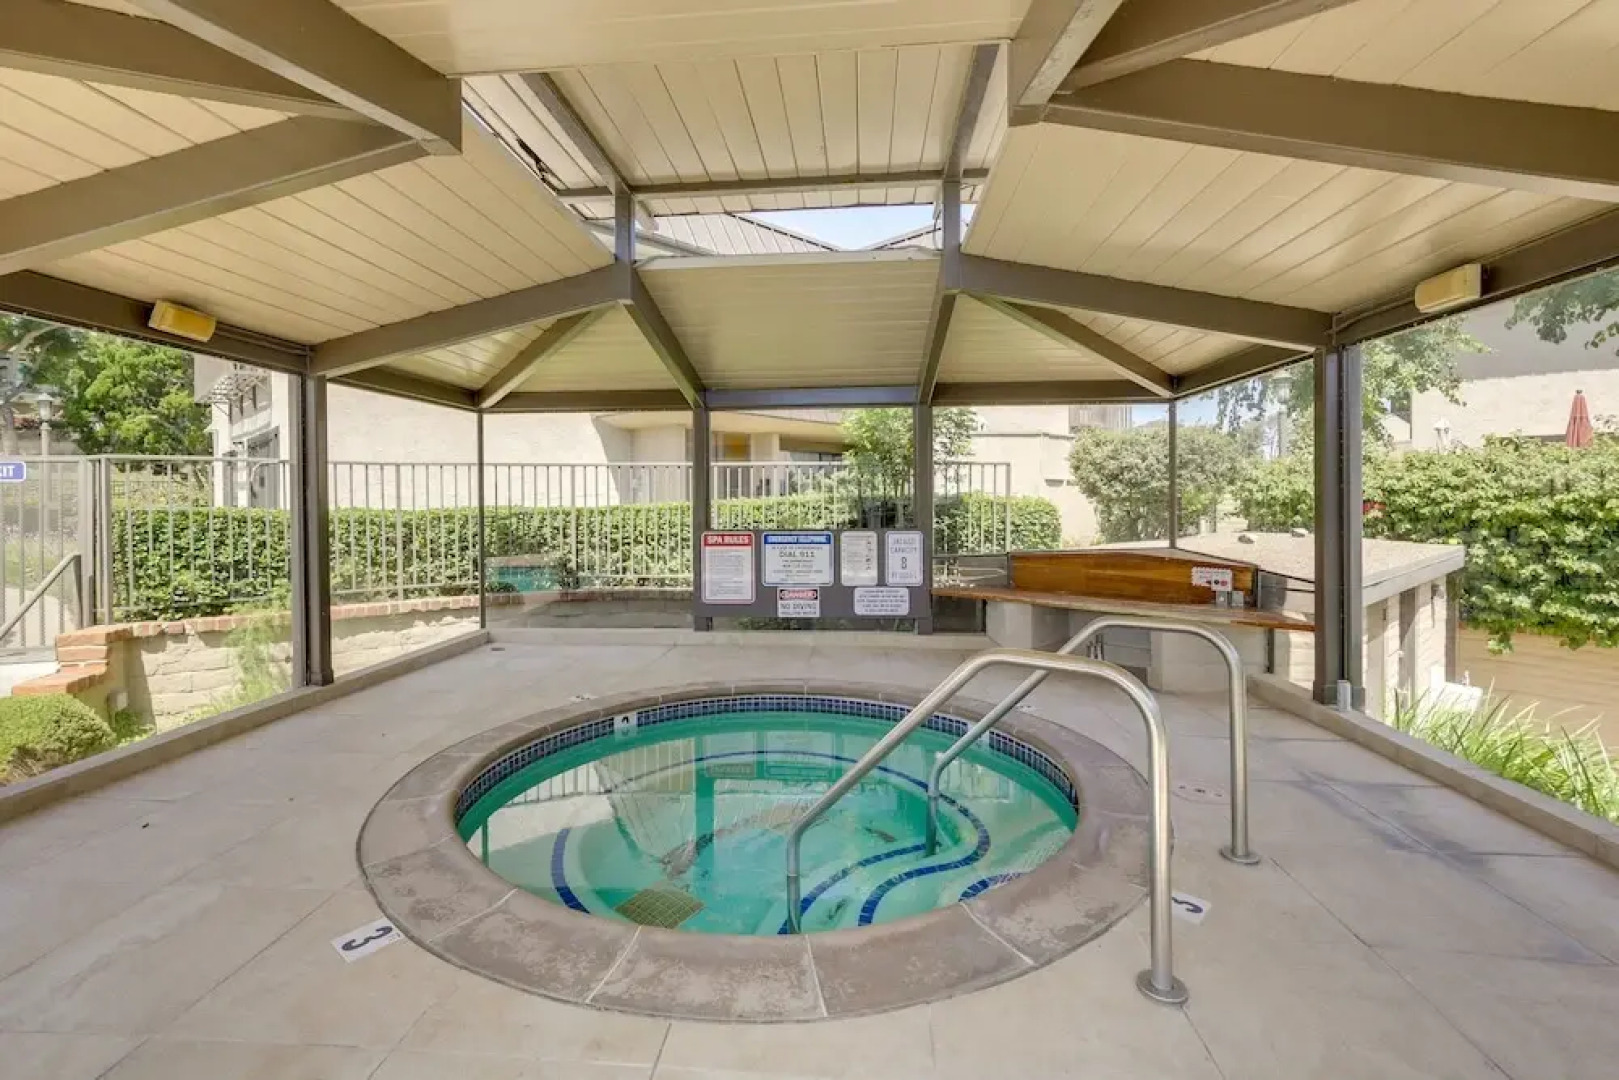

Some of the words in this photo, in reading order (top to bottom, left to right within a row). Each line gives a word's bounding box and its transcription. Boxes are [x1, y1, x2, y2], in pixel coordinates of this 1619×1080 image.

[0, 465, 15, 477] IT
[707, 535, 722, 545] SPA
[724, 535, 749, 545] RULES
[784, 590, 814, 599] DANGER
